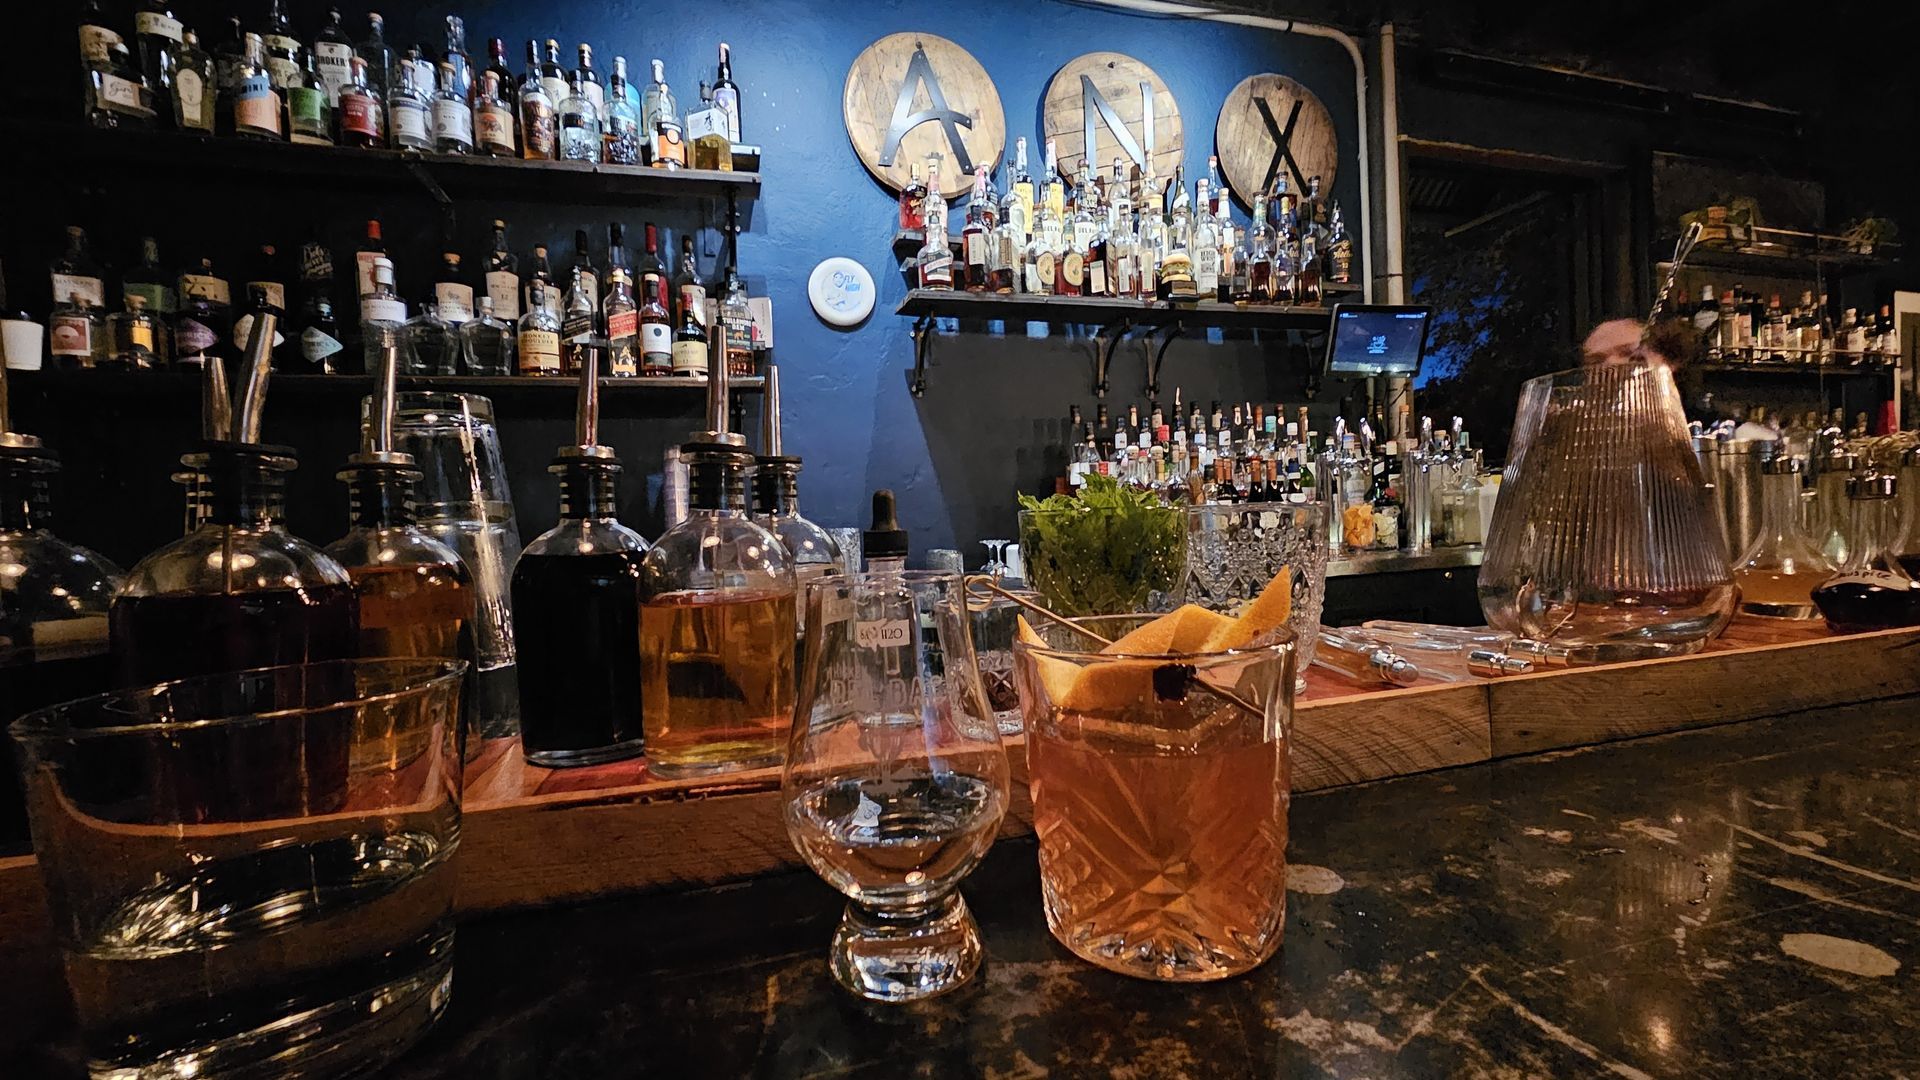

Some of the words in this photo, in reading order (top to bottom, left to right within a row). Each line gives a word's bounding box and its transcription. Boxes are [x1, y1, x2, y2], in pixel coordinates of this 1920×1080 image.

[878, 48, 973, 175] A
[1080, 75, 1155, 177] N
[1251, 96, 1309, 198] X
